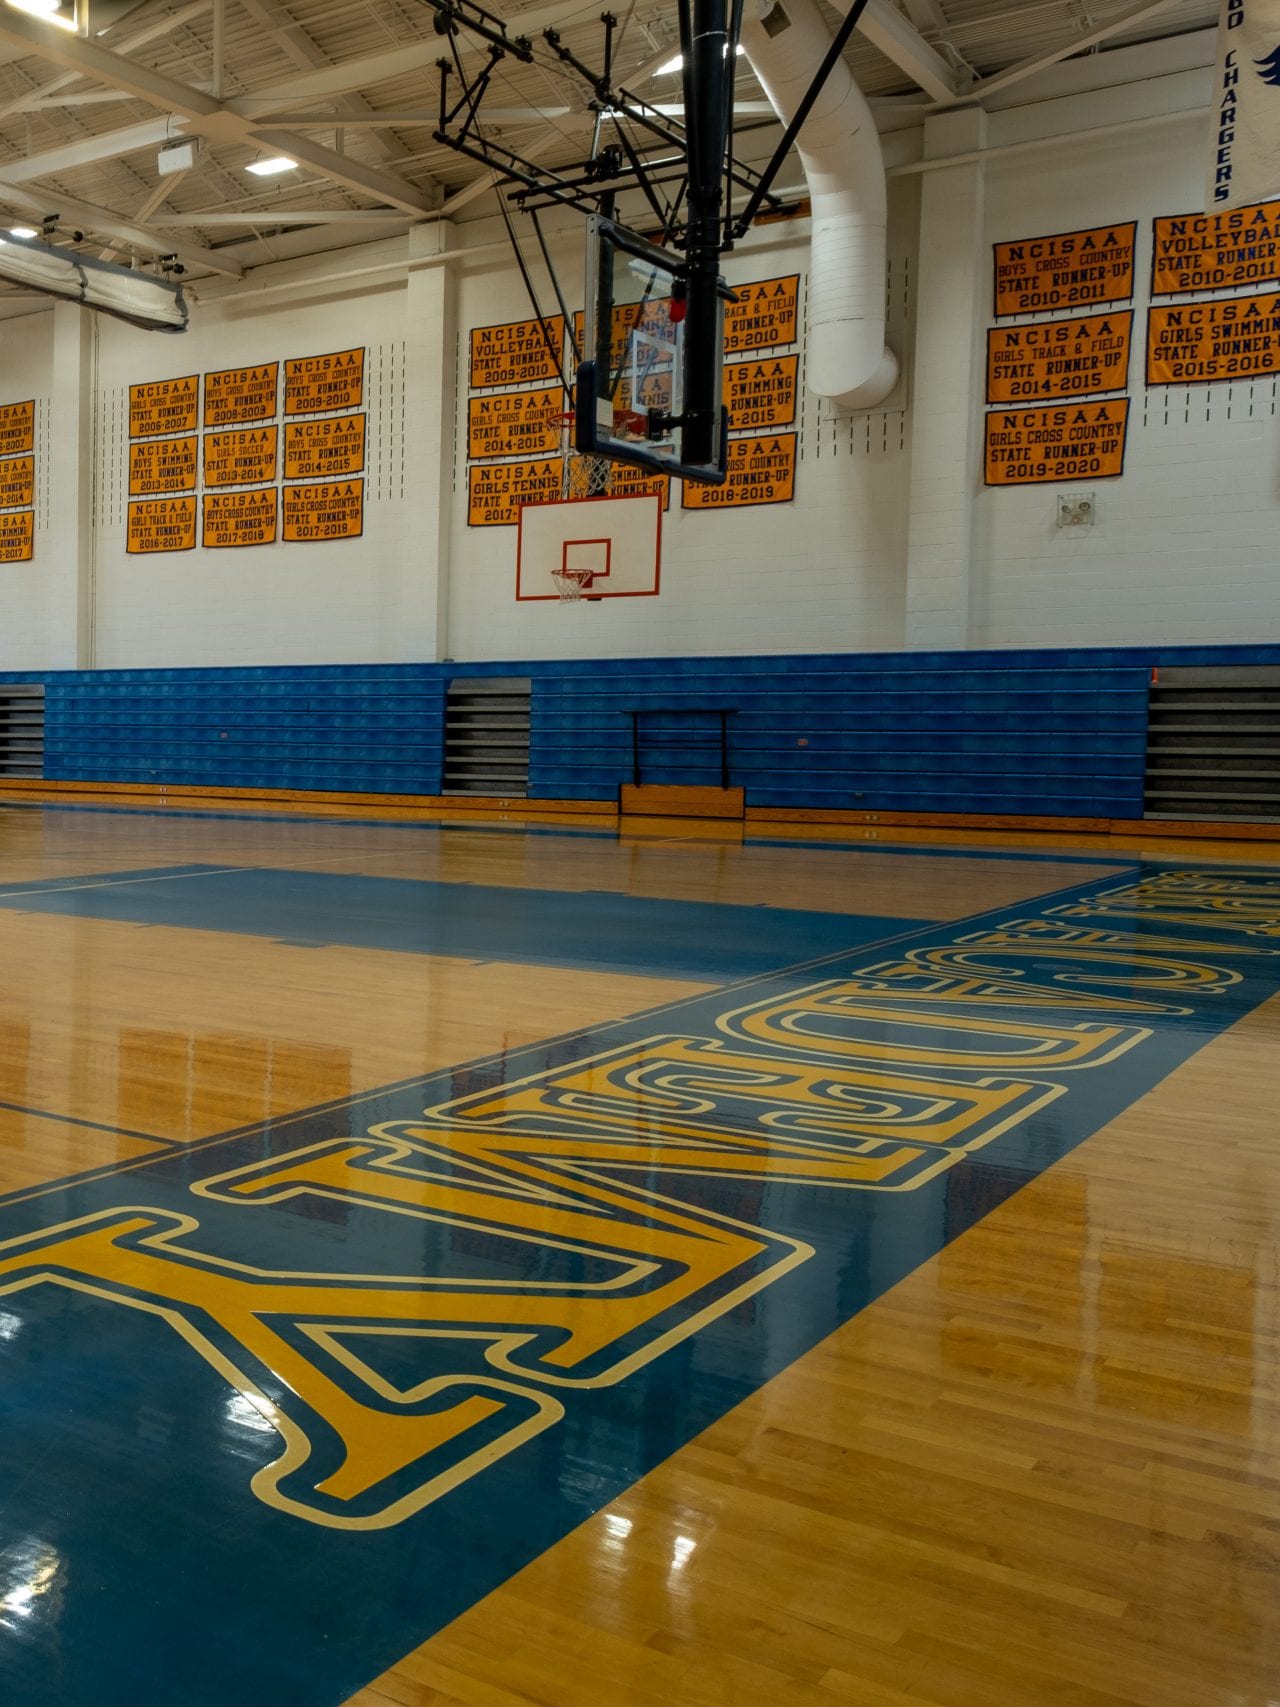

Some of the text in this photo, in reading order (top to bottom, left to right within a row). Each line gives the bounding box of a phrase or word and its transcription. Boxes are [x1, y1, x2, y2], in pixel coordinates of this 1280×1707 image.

[1214, 50, 1238, 202] CHARGERS
[1170, 209, 1280, 236] NCISA
[1009, 232, 1118, 261] NCISAA
[1162, 225, 1280, 253] VOLLEYBAL
[998, 245, 1131, 276] BOYS CROSS COUNTRY
[1158, 242, 1280, 271] STATE RUNNER-
[999, 261, 1129, 293] STATE RUNNER-UP
[1178, 261, 1273, 286] 2010-2011
[1019, 283, 1104, 307] 2010-2011
[724, 296, 794, 318] RACK & FIELD
[1166, 300, 1280, 326] NCISAA
[732, 310, 793, 332] RUNNER-UP
[1159, 317, 1280, 343] GIRLS SWIMMIN
[481, 321, 554, 343] NCISAA
[1005, 321, 1112, 346] NCISAA
[994, 335, 1124, 362] GIRLS TRACK & FIELD
[1154, 335, 1280, 361] STATE RUNNER-
[293, 354, 355, 374] NCISAA
[474, 357, 501, 371] STATE
[485, 364, 548, 382] 2009-2010
[994, 352, 1121, 379] STATE RUNNER-UP
[1172, 353, 1272, 376] 2015-2016
[136, 381, 190, 398] NCISAA
[285, 376, 361, 397] STATE RUNNER-UP
[731, 376, 792, 396] SWIMMING
[1010, 372, 1101, 395] 2014-2015
[295, 391, 350, 409] 2009-2010
[481, 394, 551, 413] NCISAA
[731, 392, 790, 411] RUNNER-UP
[132, 403, 197, 420] STATE RUNNER-UP
[472, 406, 560, 426] GIRLS CROSS COUNTRY
[1003, 407, 1109, 428] NCISAA
[138, 416, 187, 432] 2006-2007
[294, 420, 355, 437] NCISAA
[473, 426, 500, 439] STATE
[990, 421, 1121, 446] GIRLS CROSS COUNTRY
[137, 441, 189, 456] NCISAA
[288, 443, 360, 461] STATE RUNNER-UP
[484, 436, 545, 451] 2014-2015
[991, 439, 1117, 462] STATE RUNNER-UP
[132, 464, 194, 479] STATE RUNNER-UP
[298, 457, 350, 473] 2014-2015
[481, 464, 552, 480] NCISAA
[749, 454, 790, 471] COUNTRY
[1005, 458, 1100, 477] 2019-2020
[140, 477, 185, 490] 2013-2014
[474, 477, 559, 494] GIRLS TENNIS
[611, 480, 664, 495] RUNNER-UP
[730, 470, 789, 486] RUNNER-UP
[212, 492, 268, 508] NCISAA
[292, 484, 353, 500] NCISAA
[472, 490, 560, 508] STATE RUNNER-UP
[702, 488, 773, 503] 2018-2019
[206, 516, 274, 531] STATE RUNNER-UP
[485, 508, 518, 520] 2017-
[216, 529, 264, 543] 2017-2018
[296, 522, 348, 536] 2017-2018
